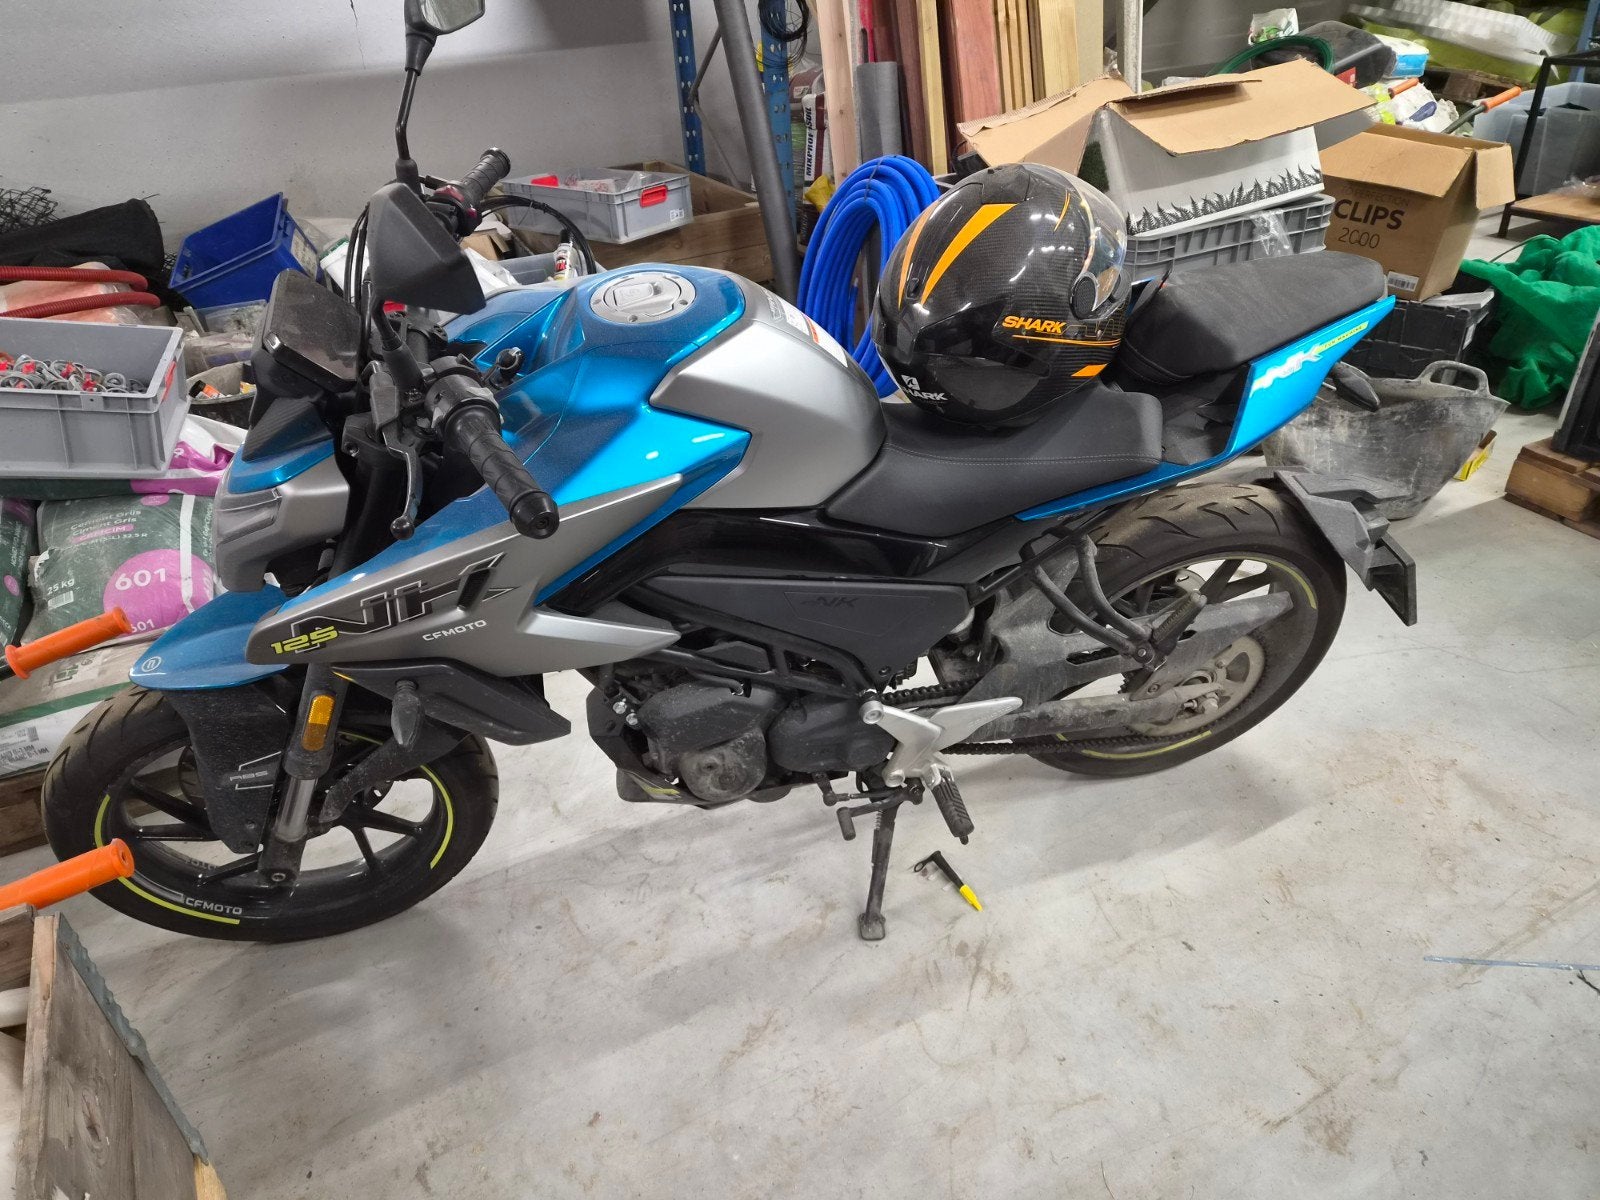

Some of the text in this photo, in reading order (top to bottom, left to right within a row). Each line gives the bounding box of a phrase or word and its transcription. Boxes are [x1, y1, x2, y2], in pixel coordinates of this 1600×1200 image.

[1334, 198, 1406, 231] CLIPS
[1338, 227, 1380, 249] 2000
[1002, 315, 1067, 334] SHARK
[47, 578, 75, 596] 25 kg
[114, 568, 167, 591] 601
[270, 625, 339, 655] 125
[422, 619, 488, 641] CFMOTO
[185, 897, 243, 915] CFMOTO
